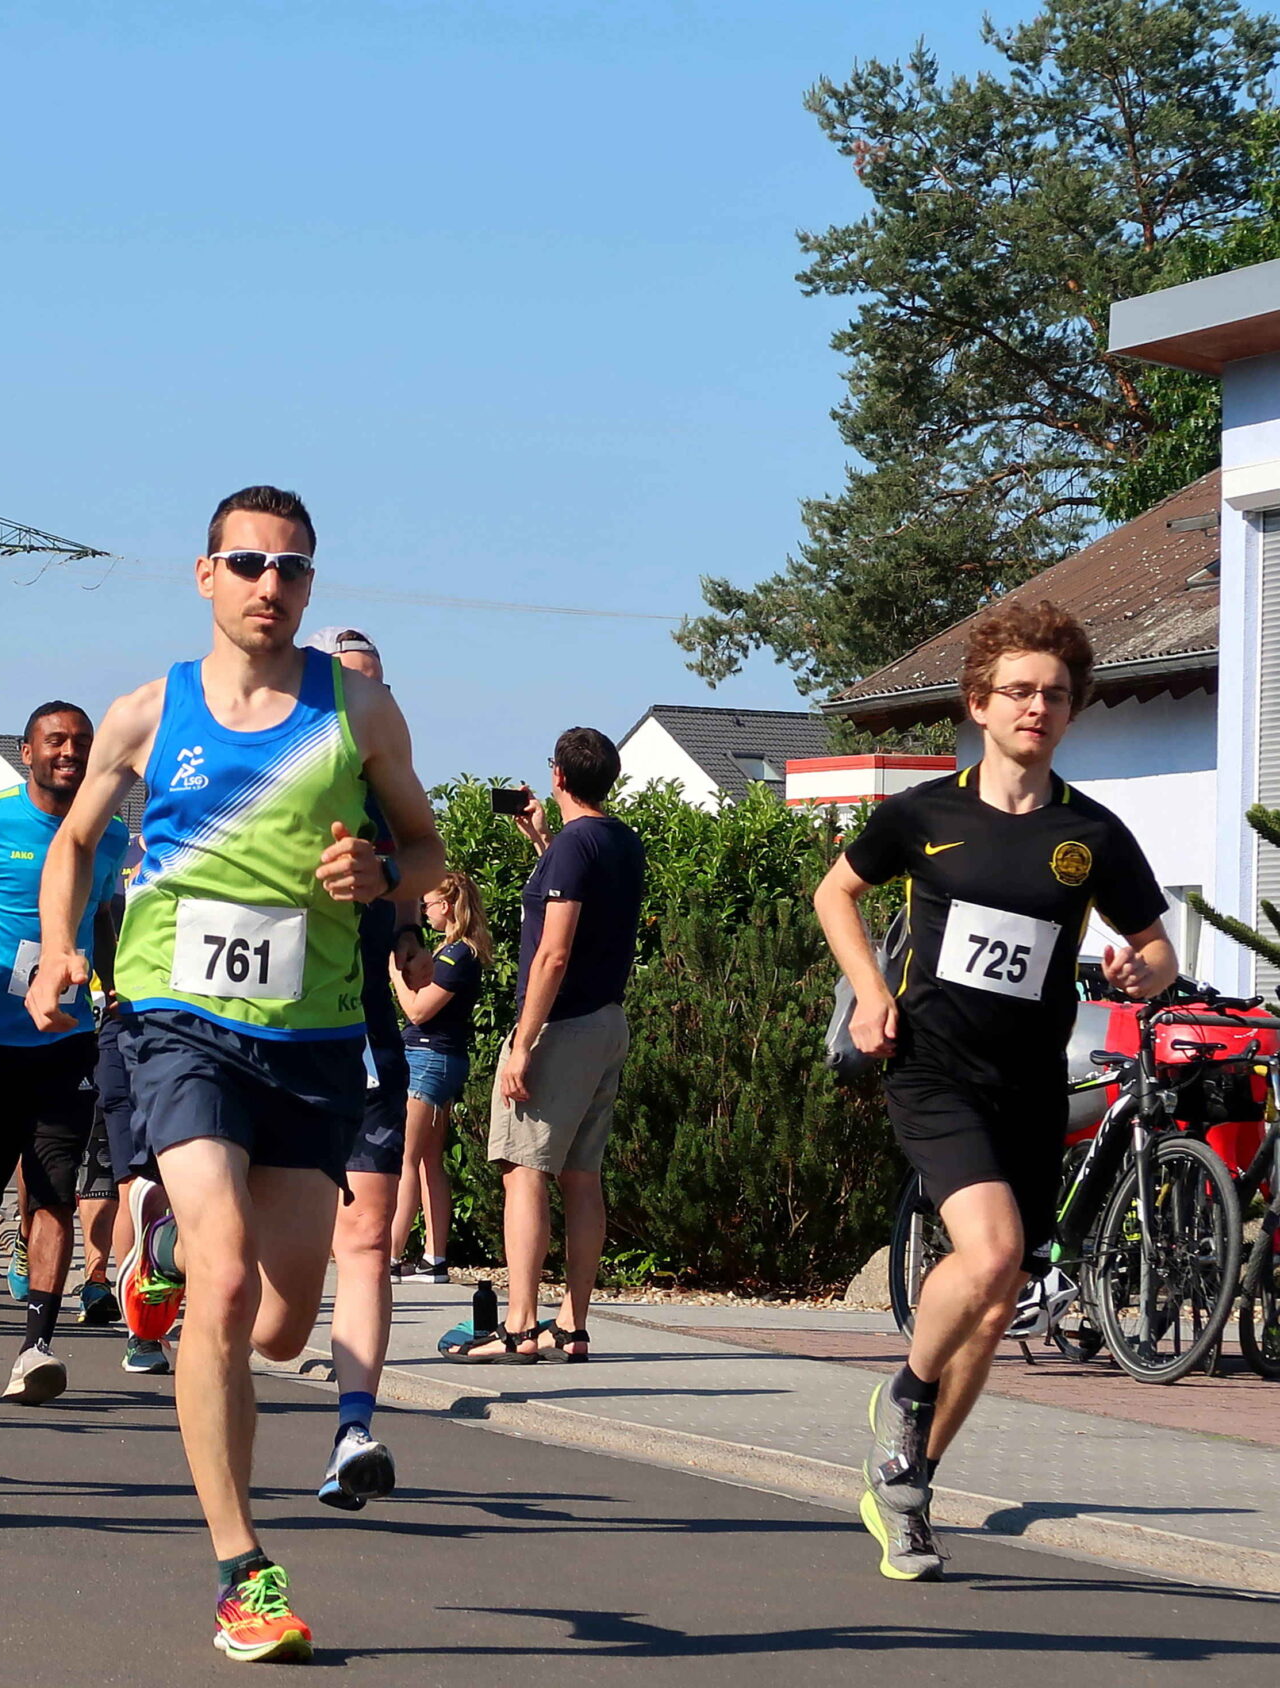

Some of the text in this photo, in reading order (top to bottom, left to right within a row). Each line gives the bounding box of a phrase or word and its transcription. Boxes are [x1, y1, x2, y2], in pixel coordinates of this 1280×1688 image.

[10, 850, 34, 860] JAKO
[203, 934, 270, 985] 761
[965, 933, 1032, 984] 725
